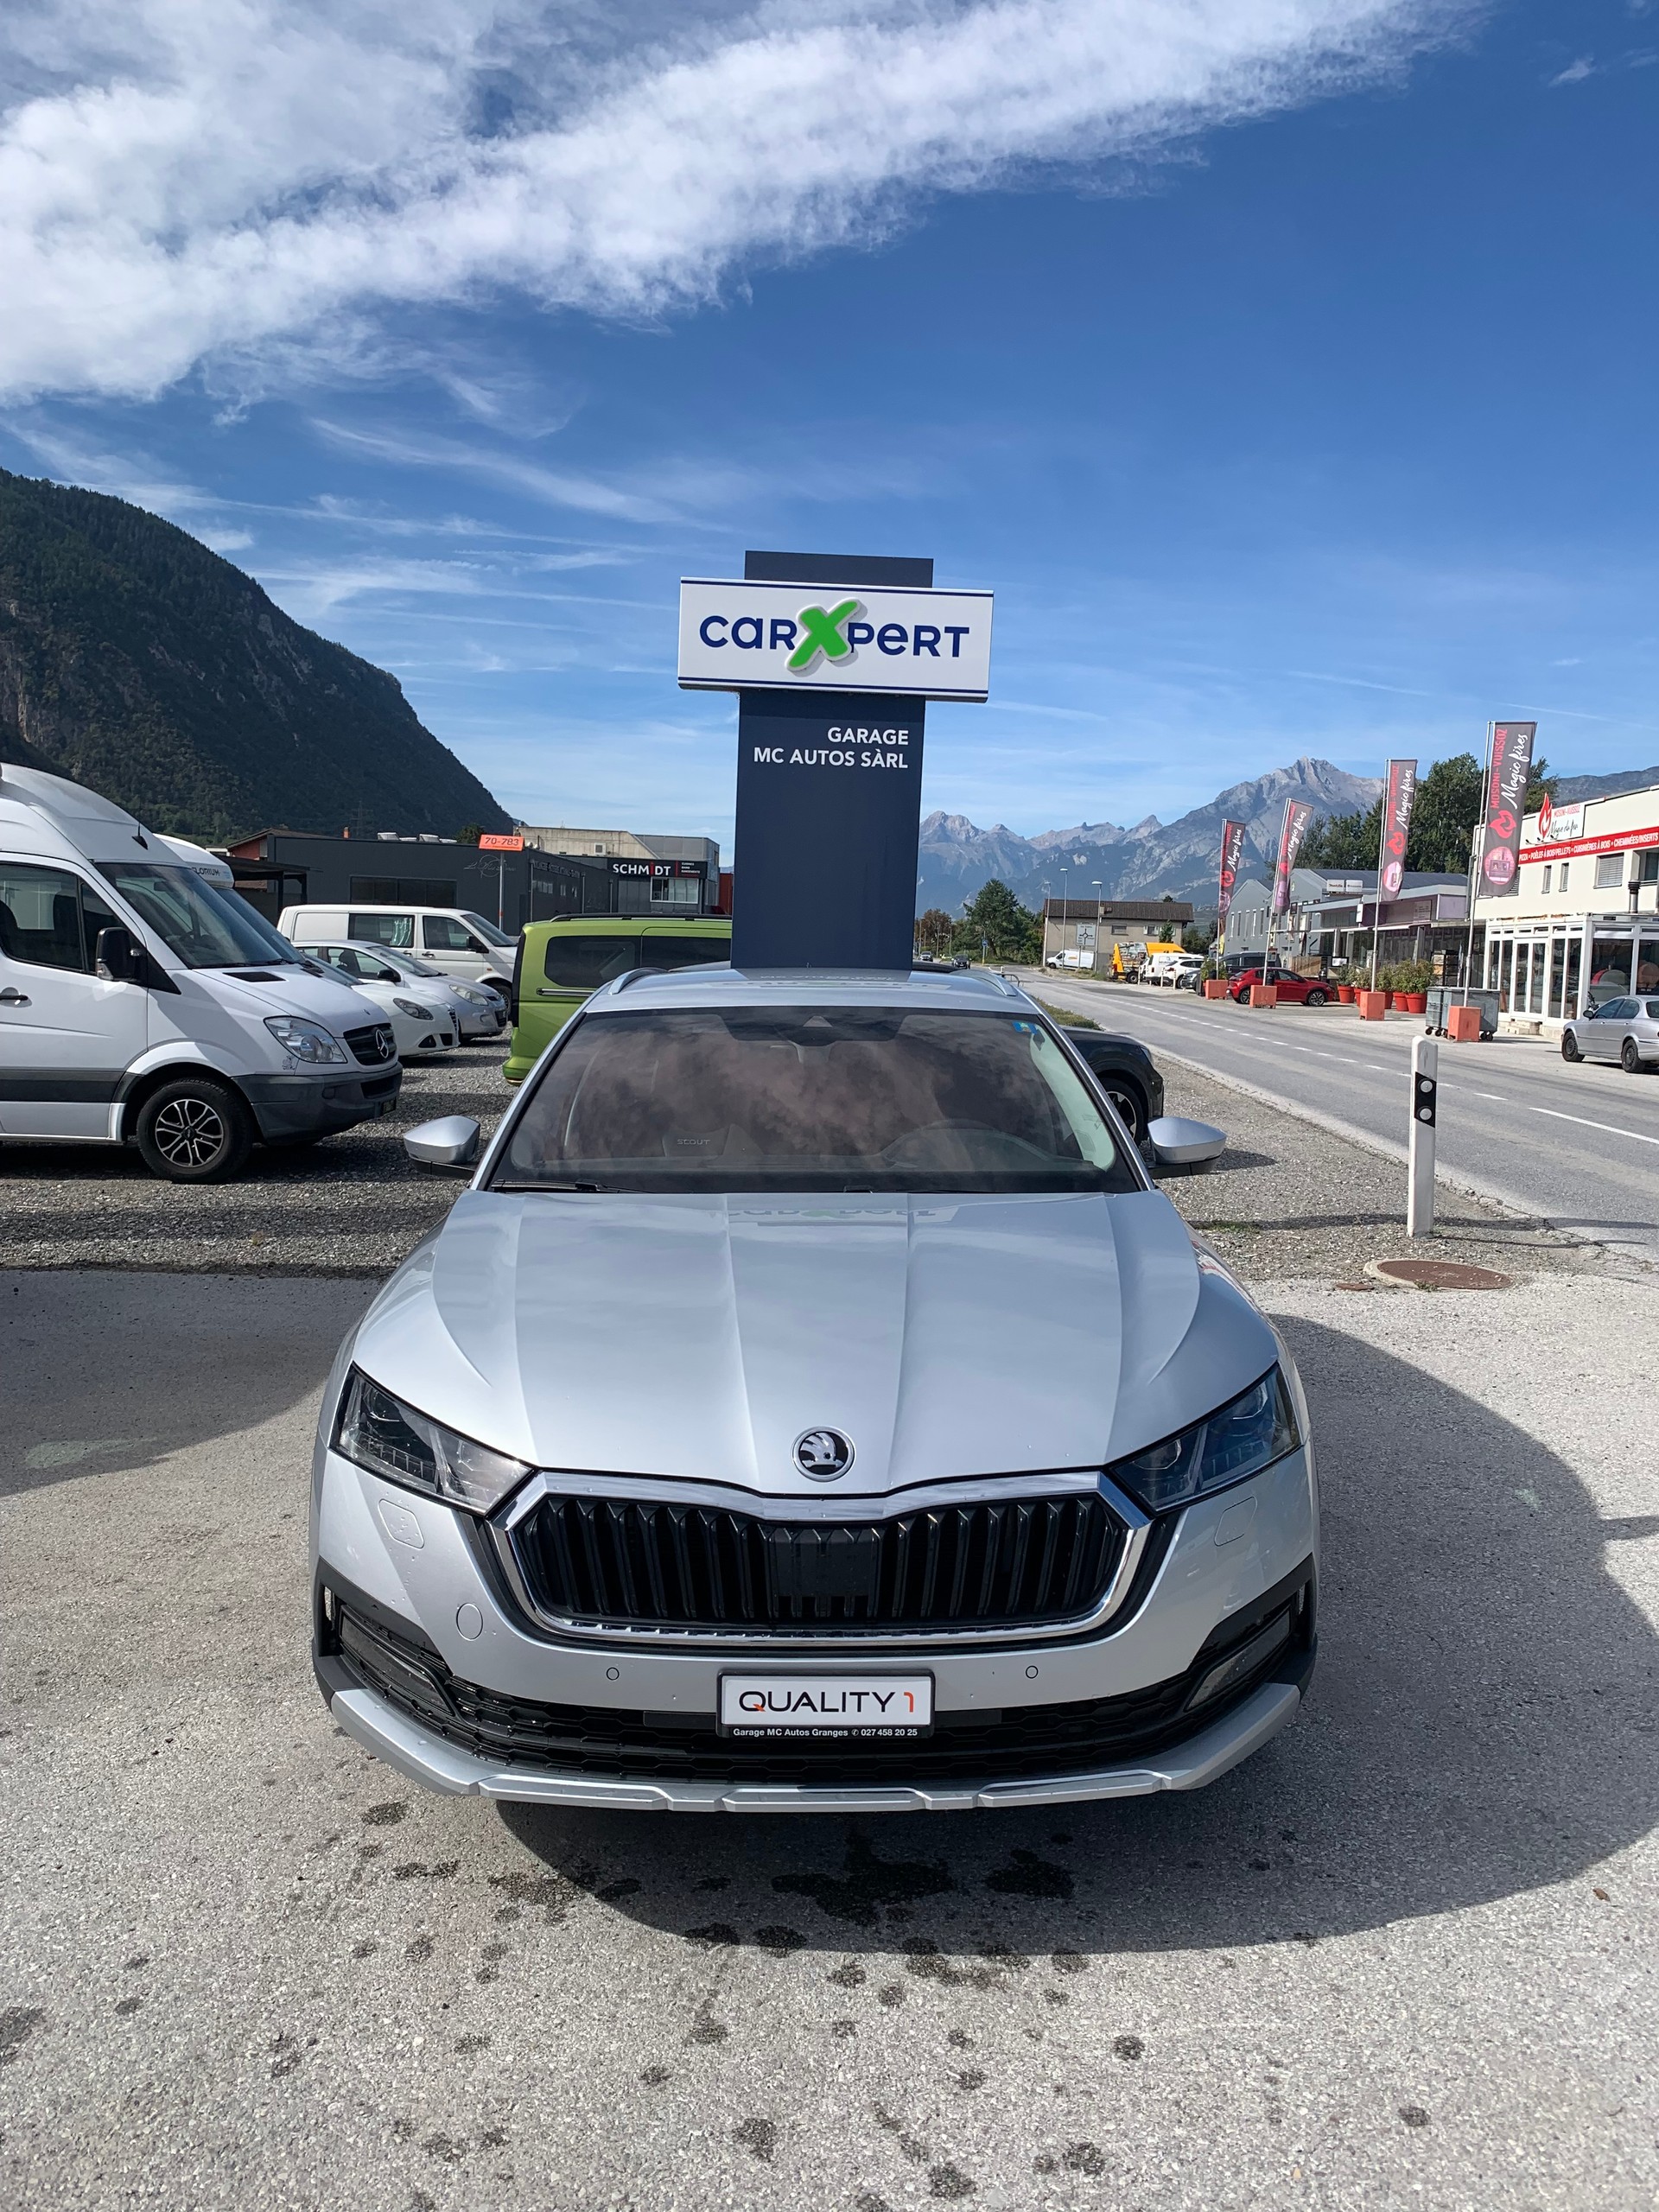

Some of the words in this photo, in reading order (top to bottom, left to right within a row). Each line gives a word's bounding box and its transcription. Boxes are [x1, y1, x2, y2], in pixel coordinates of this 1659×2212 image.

[827, 727, 909, 747] GARAGE
[1508, 734, 1529, 762] fires
[753, 747, 784, 764] MC
[790, 748, 855, 766] AUTOS
[861, 748, 908, 769] SÀRL
[1491, 728, 1508, 809] MOSONI-VUISSOZ
[1400, 769, 1414, 792] fires
[1500, 761, 1526, 810] Magic
[484, 836, 519, 846] 70-783
[613, 861, 671, 876] SCHMIDT
[739, 1691, 896, 1713] QUALITY
[903, 1692, 914, 1713] 1
[733, 1728, 765, 1737] Garage
